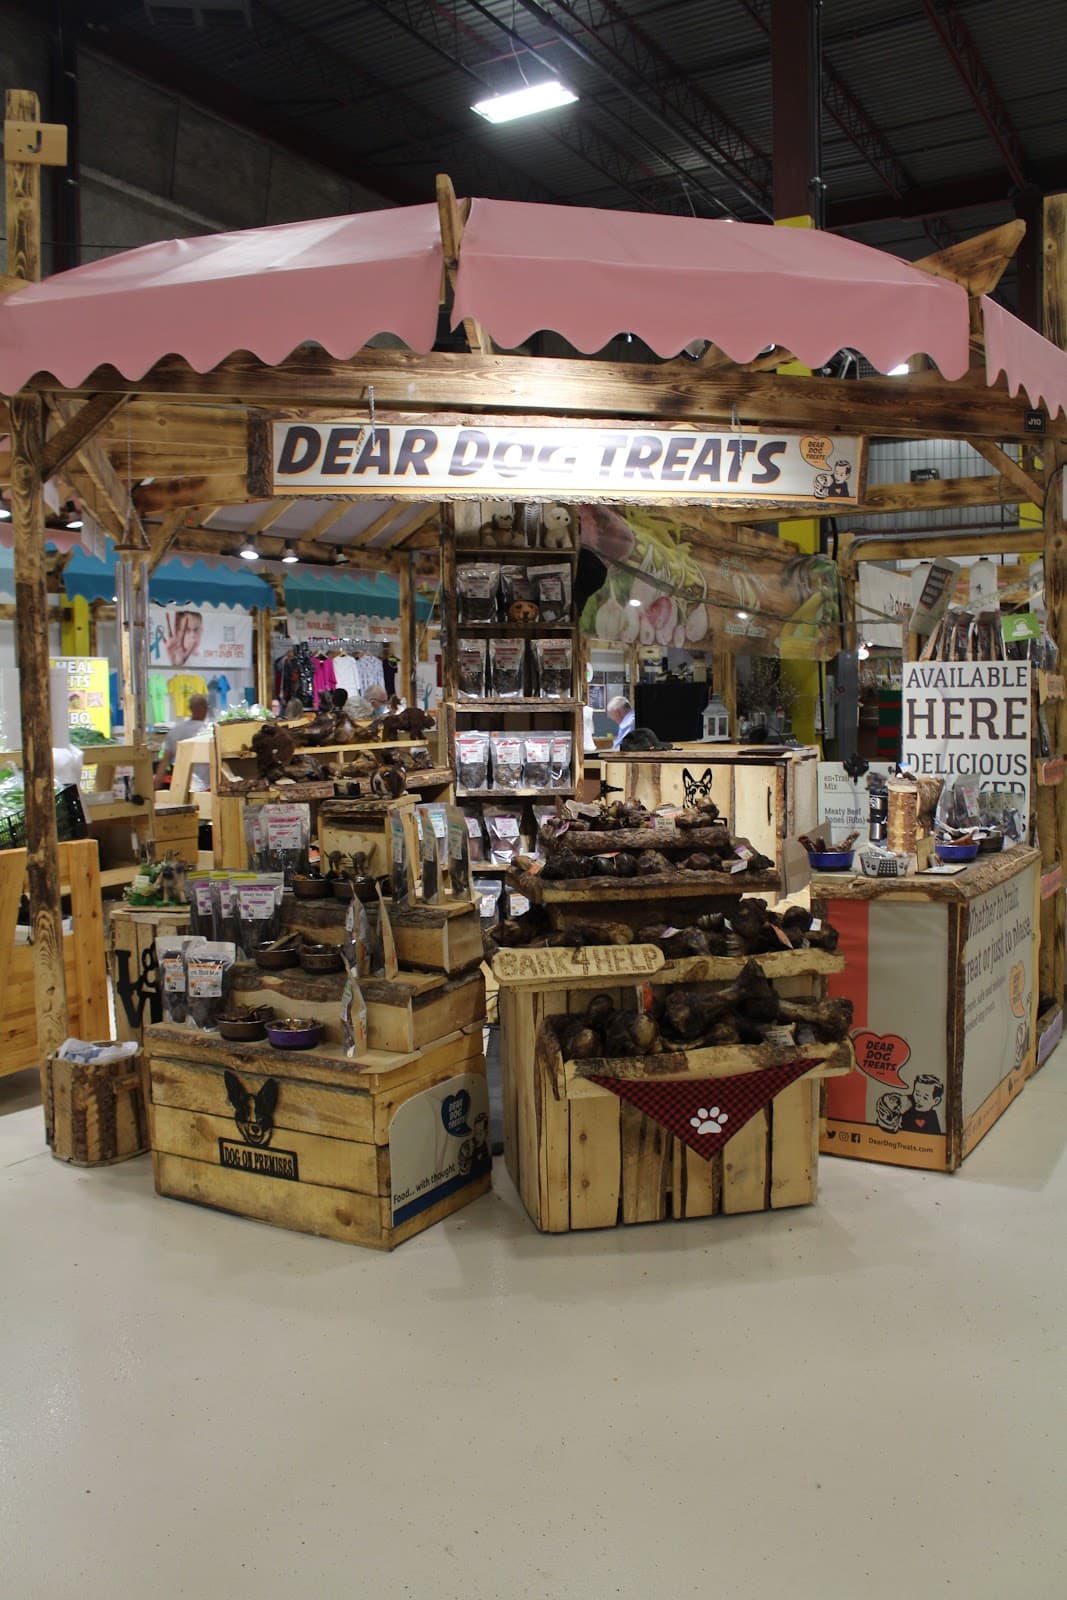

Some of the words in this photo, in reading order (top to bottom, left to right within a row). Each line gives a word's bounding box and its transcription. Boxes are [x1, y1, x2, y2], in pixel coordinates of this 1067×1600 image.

[27, 129, 43, 154] J
[1027, 417, 1043, 426] J10
[807, 441, 826, 449] DEAR
[807, 447, 824, 455] DOG
[277, 426, 438, 476] DEAR
[447, 430, 577, 479] DOG
[598, 434, 788, 484] TREATS
[905, 666, 1028, 689] AVAILABLE
[905, 697, 1028, 740] HERE
[905, 753, 1028, 776] DELICIOUS
[824, 783, 838, 791] Mix
[846, 807, 862, 816] Beef
[865, 1040, 895, 1052] DEAR
[866, 1050, 892, 1061] DOG
[862, 1059, 897, 1072] TREATS
[448, 1098, 463, 1113] DEAR
[448, 1110, 463, 1121] DOG
[868, 1136, 934, 1154] DearDogTreats.com
[223, 1146, 241, 1166] DOG
[241, 1150, 254, 1169] ON
[254, 1151, 294, 1177] PREMISES
[415, 1176, 431, 1193] with
[430, 1163, 456, 1185] thought
